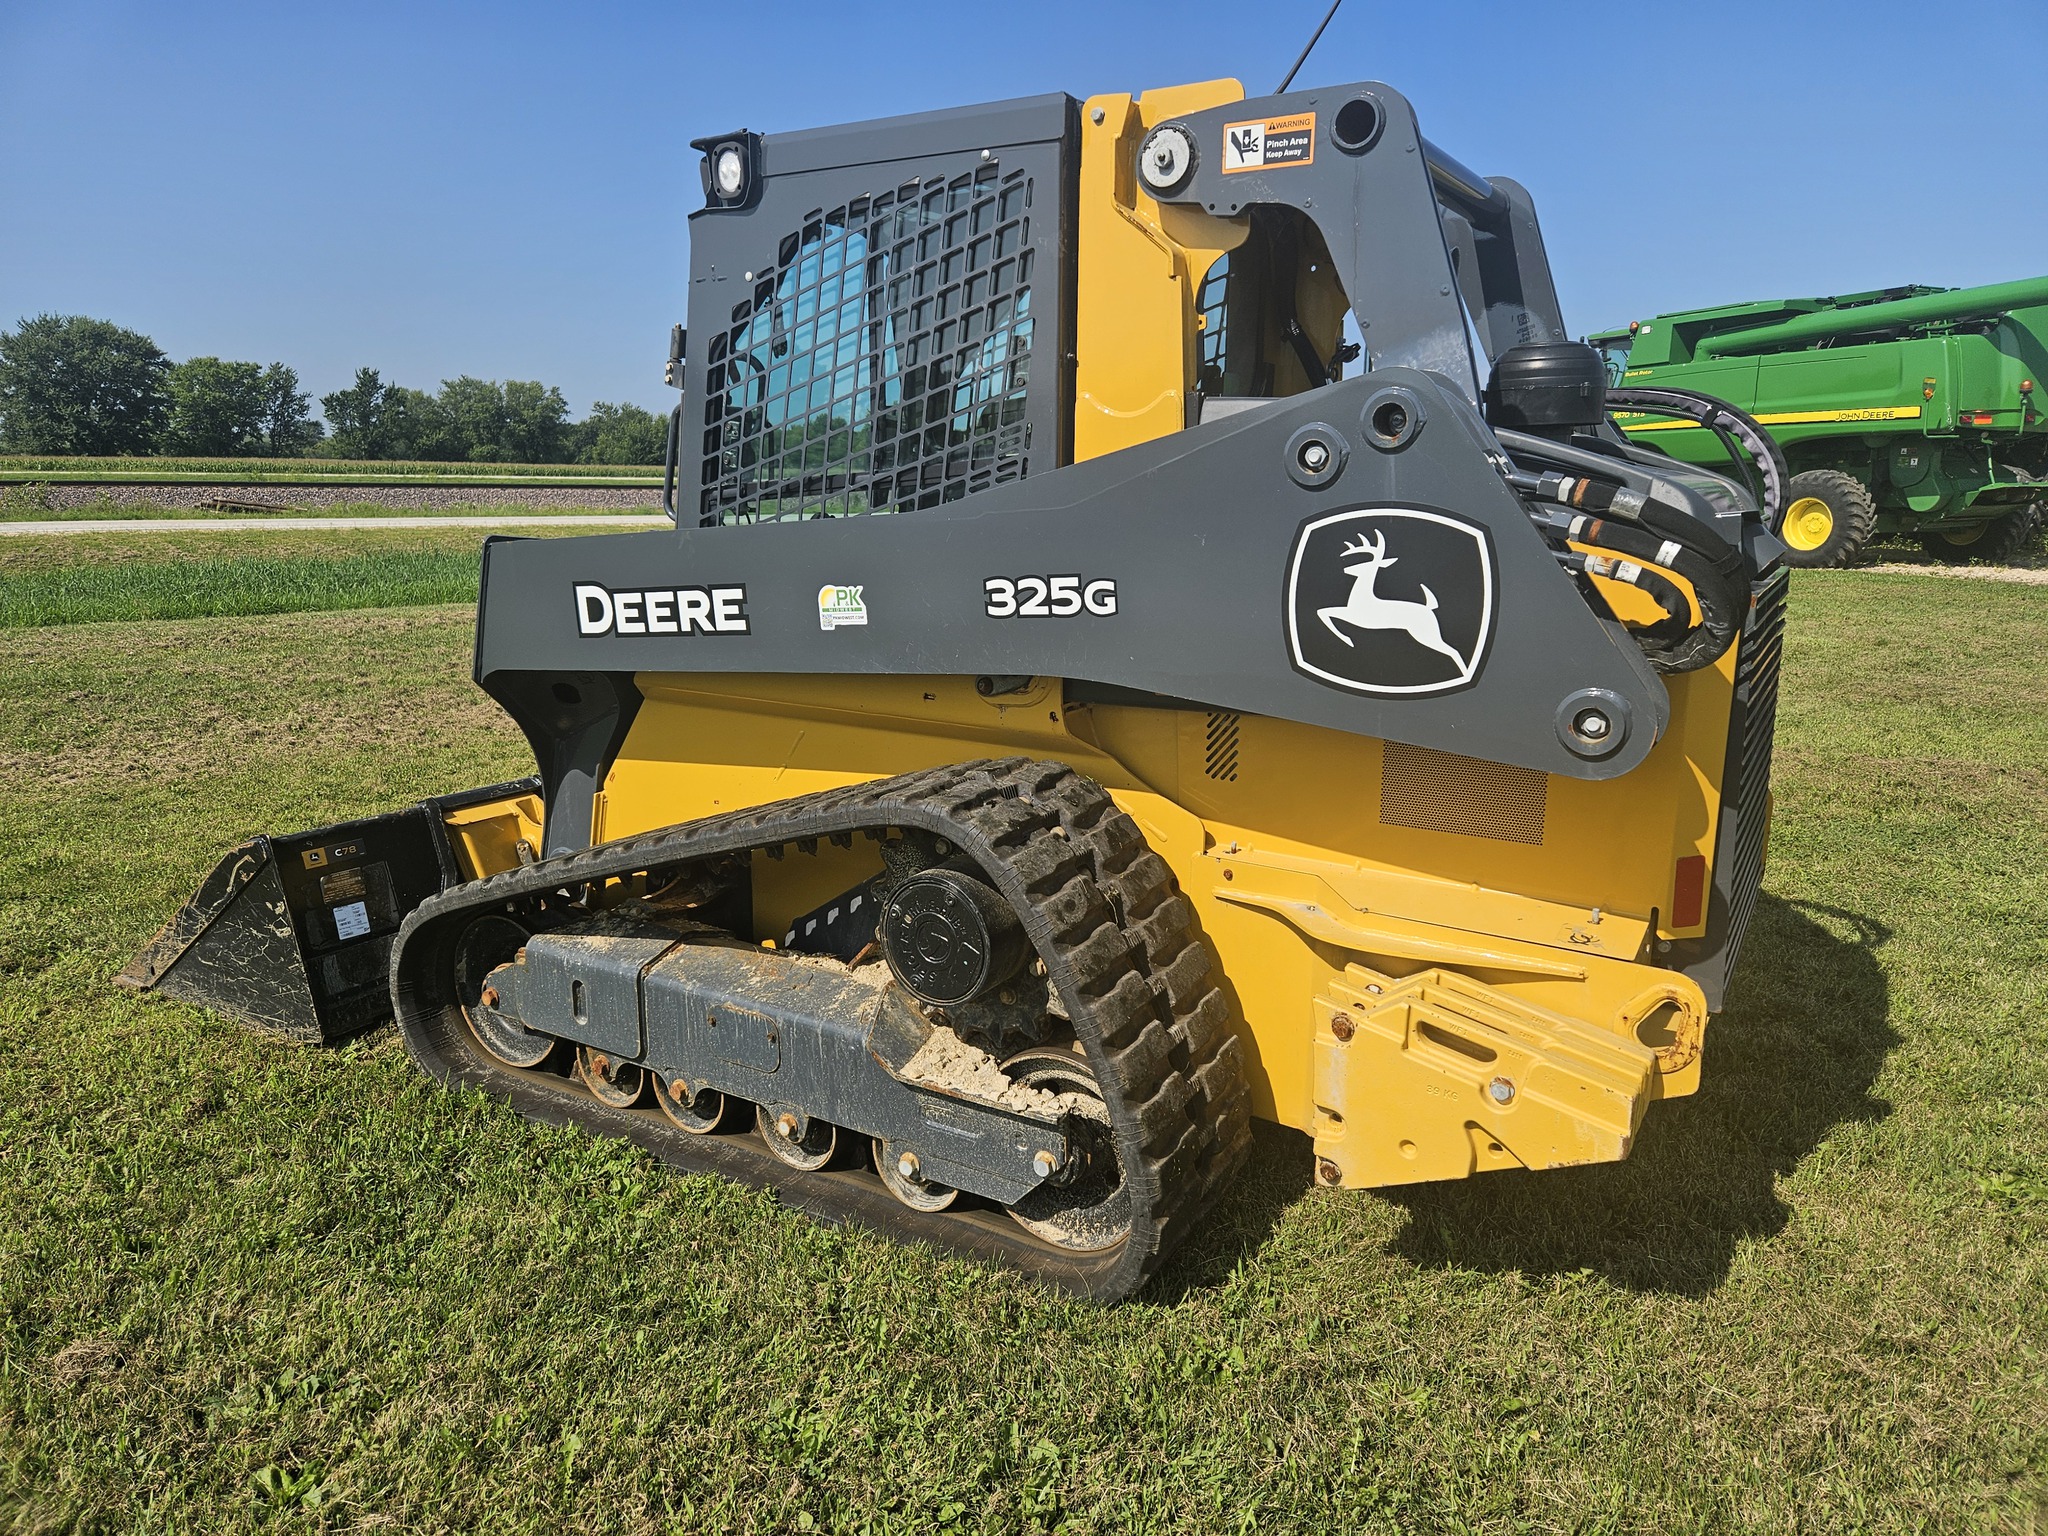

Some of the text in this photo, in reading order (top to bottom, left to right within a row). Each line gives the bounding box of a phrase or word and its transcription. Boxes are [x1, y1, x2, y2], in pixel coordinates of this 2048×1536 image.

[1275, 119, 1310, 129] WARNING
[1267, 137, 1308, 148] Pinch Area
[1266, 148, 1302, 158] Keep Away
[1836, 411, 1894, 420] JOHN DEERE
[985, 577, 1116, 616] 325G
[575, 585, 747, 634] DEERE
[335, 845, 357, 857] C78
[1443, 1089, 1458, 1101] KG
